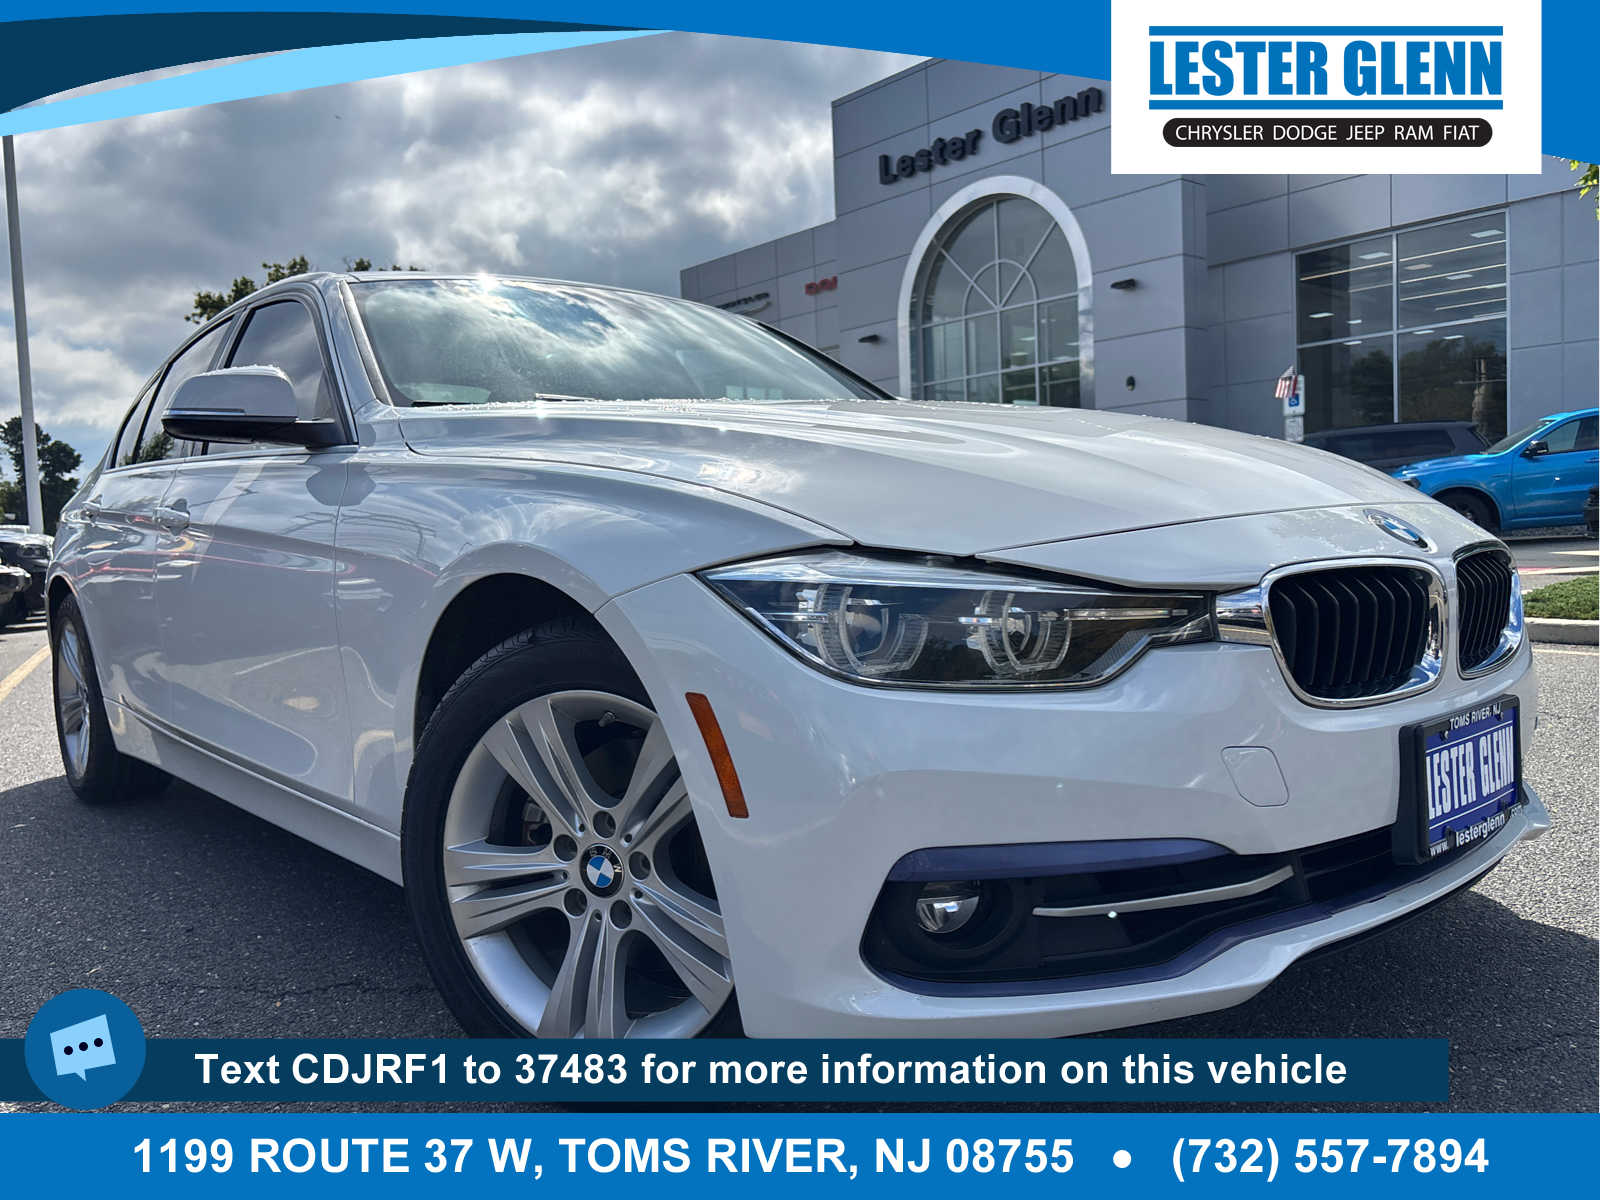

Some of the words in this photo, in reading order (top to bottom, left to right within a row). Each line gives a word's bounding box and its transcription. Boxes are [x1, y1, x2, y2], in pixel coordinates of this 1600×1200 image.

[878, 128, 983, 185] Lester
[991, 86, 1104, 144] Glenn
[1449, 713, 1471, 730] TOMS
[1492, 703, 1502, 715] NJ
[1426, 742, 1476, 819] LESTER
[1479, 725, 1514, 797] GLENN
[1455, 813, 1506, 847] lesterglenn
